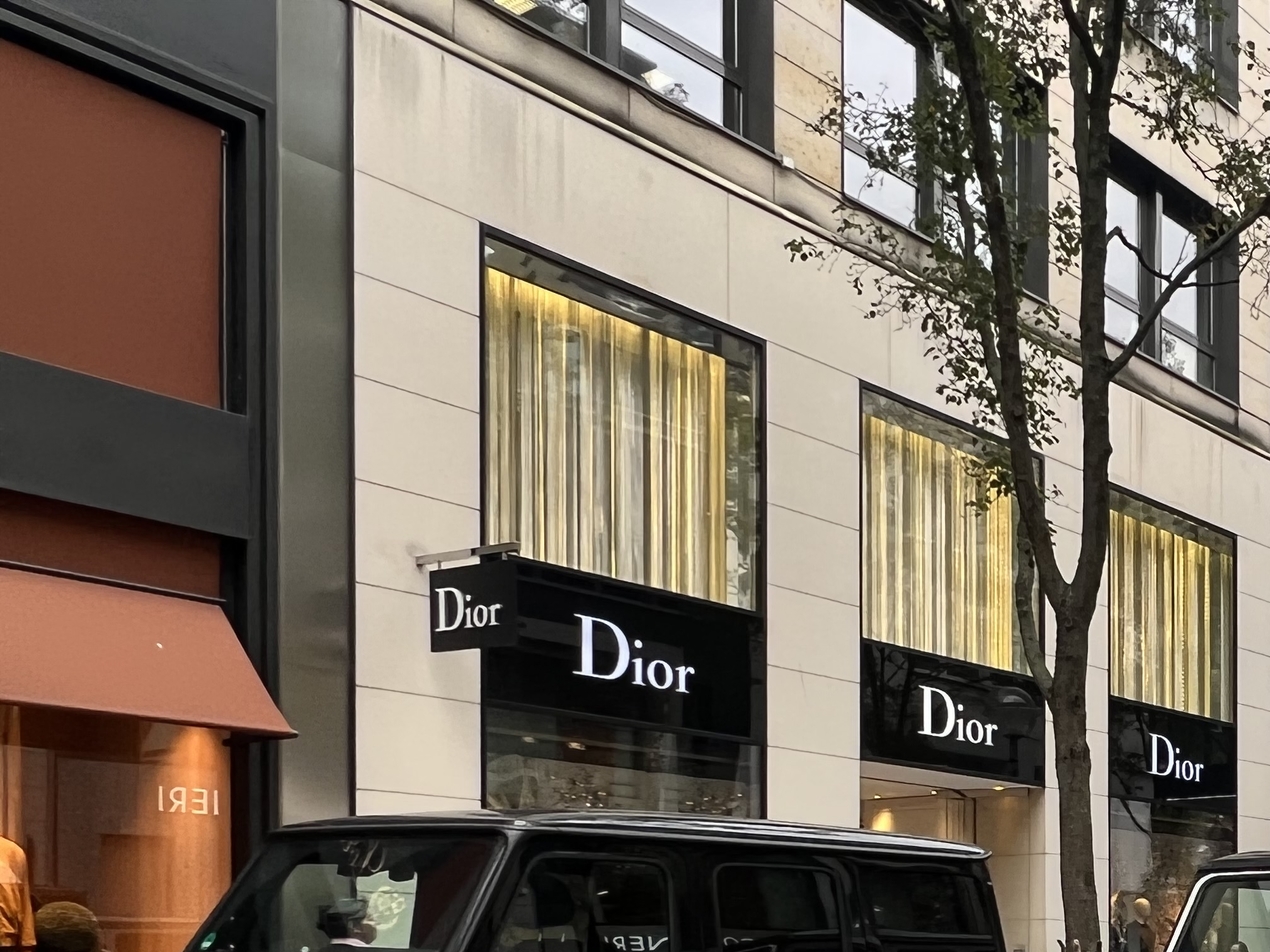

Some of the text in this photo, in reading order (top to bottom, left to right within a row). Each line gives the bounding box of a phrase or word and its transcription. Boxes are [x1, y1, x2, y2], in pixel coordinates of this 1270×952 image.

[434, 587, 502, 632] Dior
[572, 613, 695, 695] Dior
[917, 684, 999, 747] Dior
[1148, 732, 1204, 782] Dior
